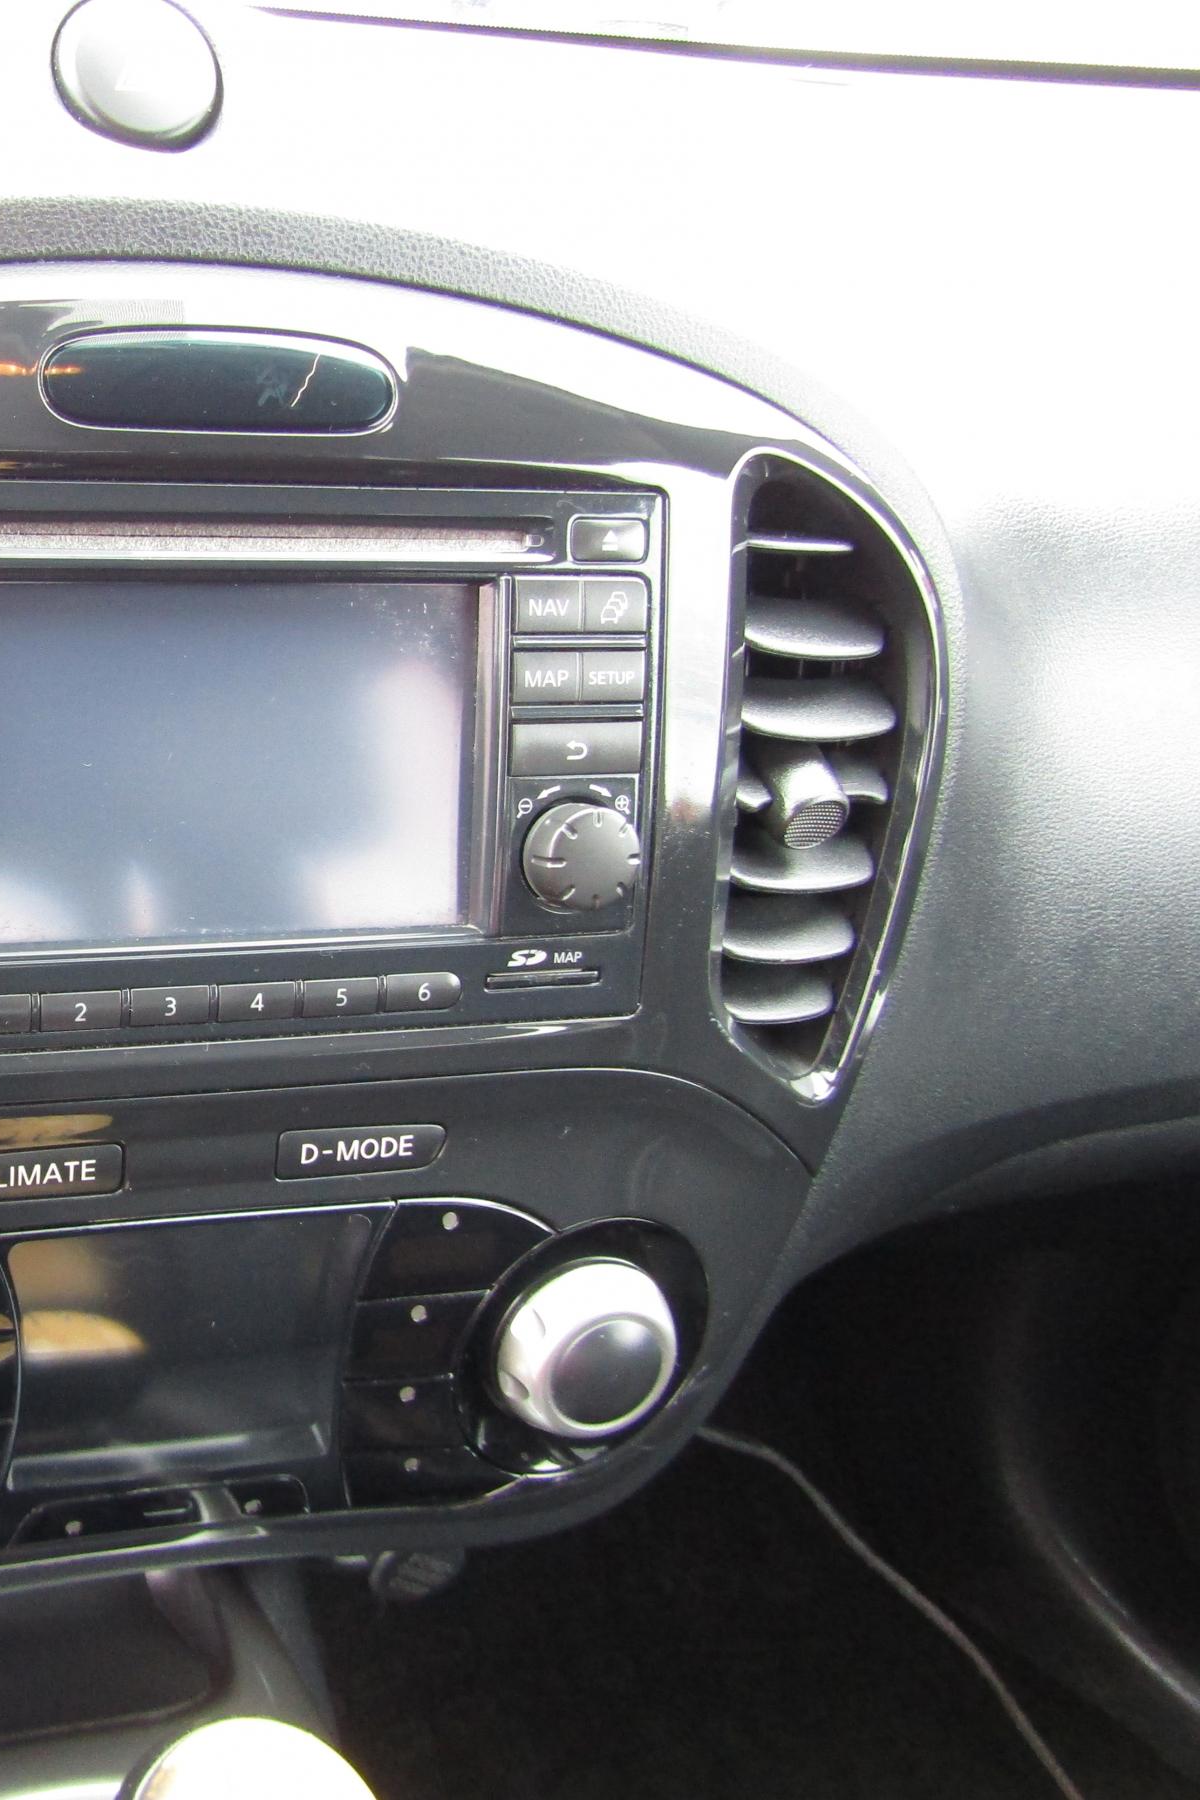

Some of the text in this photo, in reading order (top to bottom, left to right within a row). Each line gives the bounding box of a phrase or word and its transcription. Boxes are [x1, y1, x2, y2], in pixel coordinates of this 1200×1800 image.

[528, 598, 570, 617] NAV
[524, 669, 569, 688] MAP
[588, 670, 636, 685] SETUP
[553, 951, 582, 964] MAP
[335, 988, 348, 1007] 5
[417, 982, 431, 1001] 6
[164, 996, 177, 1016] 3
[250, 992, 264, 1012] 4
[74, 1002, 87, 1022] 2
[300, 1135, 415, 1165] D-MODE
